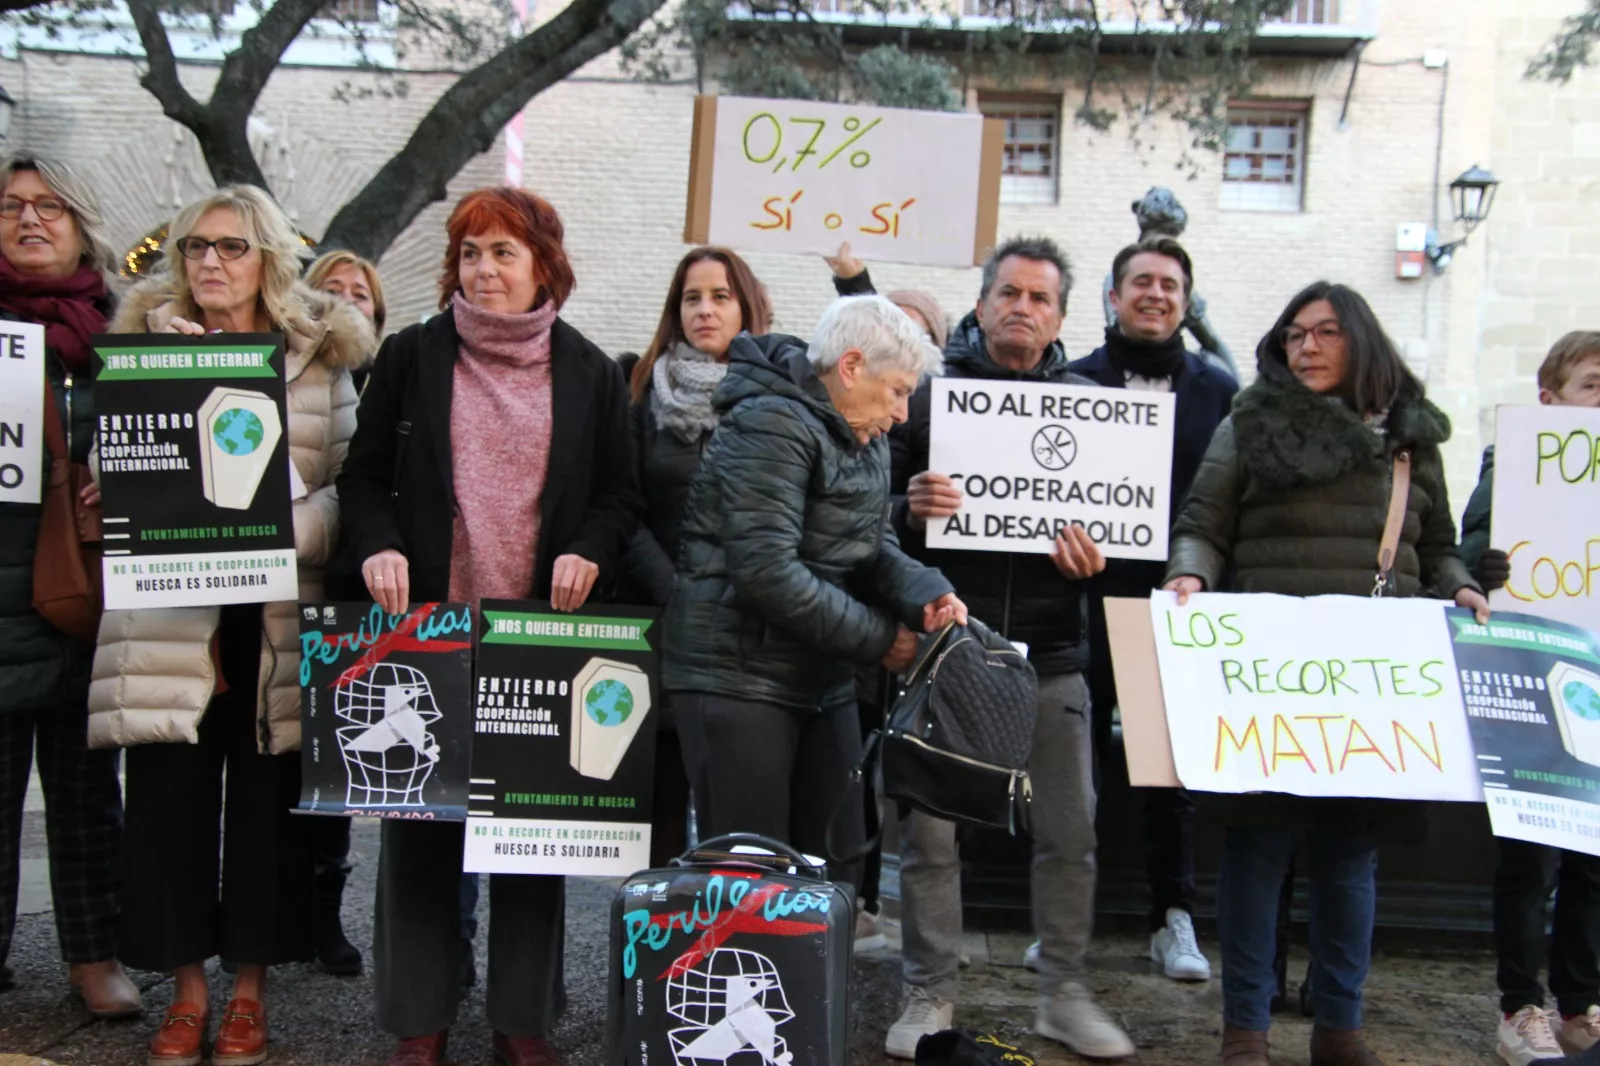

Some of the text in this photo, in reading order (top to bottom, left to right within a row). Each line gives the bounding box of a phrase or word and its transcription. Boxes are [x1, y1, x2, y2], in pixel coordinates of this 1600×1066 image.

[743, 112, 883, 174] 0,7%
[140, 353, 193, 370] QUIEREN
[197, 352, 265, 368] ENTERRAR!
[947, 390, 1158, 427] NO AL RECORTE
[100, 412, 194, 431] ENTIERRO
[100, 431, 155, 445] POR LA
[100, 441, 180, 458] COOPERACIÓN
[101, 457, 191, 473] INTERNACIONAL
[948, 473, 1155, 509] OOPERACIÓN
[140, 525, 278, 541] AYUNTAMIENTO DE HUESCA
[943, 513, 977, 537] AL
[112, 556, 288, 575] NO AL RECORTE EN COOPERACIÓN
[136, 574, 268, 592] HUESCA ES SOLIDARIA
[525, 620, 574, 637] QUIEREN
[577, 623, 640, 640] ENTERRAR!
[1166, 610, 1244, 648] LOS
[478, 677, 568, 696] ENTIERRO
[1220, 658, 1445, 697] RECORTES
[1460, 669, 1546, 691] ENTIERRO
[1463, 683, 1514, 698] POR LA
[477, 694, 530, 708] POR LA
[476, 707, 552, 722] COOPERACIÓN
[1467, 706, 1549, 725] INTERNACIONAL
[475, 721, 560, 736] INTERNACIONAL
[1214, 714, 1443, 777] MATAN
[504, 792, 636, 809] AYUNTAMIENTO DE HUESCA
[1517, 812, 1557, 830] HUESCA
[474, 826, 642, 842] NO AL RECORTE EN COOPERACIÓN
[494, 842, 620, 859] HUESCA ES SOLIDARIA
